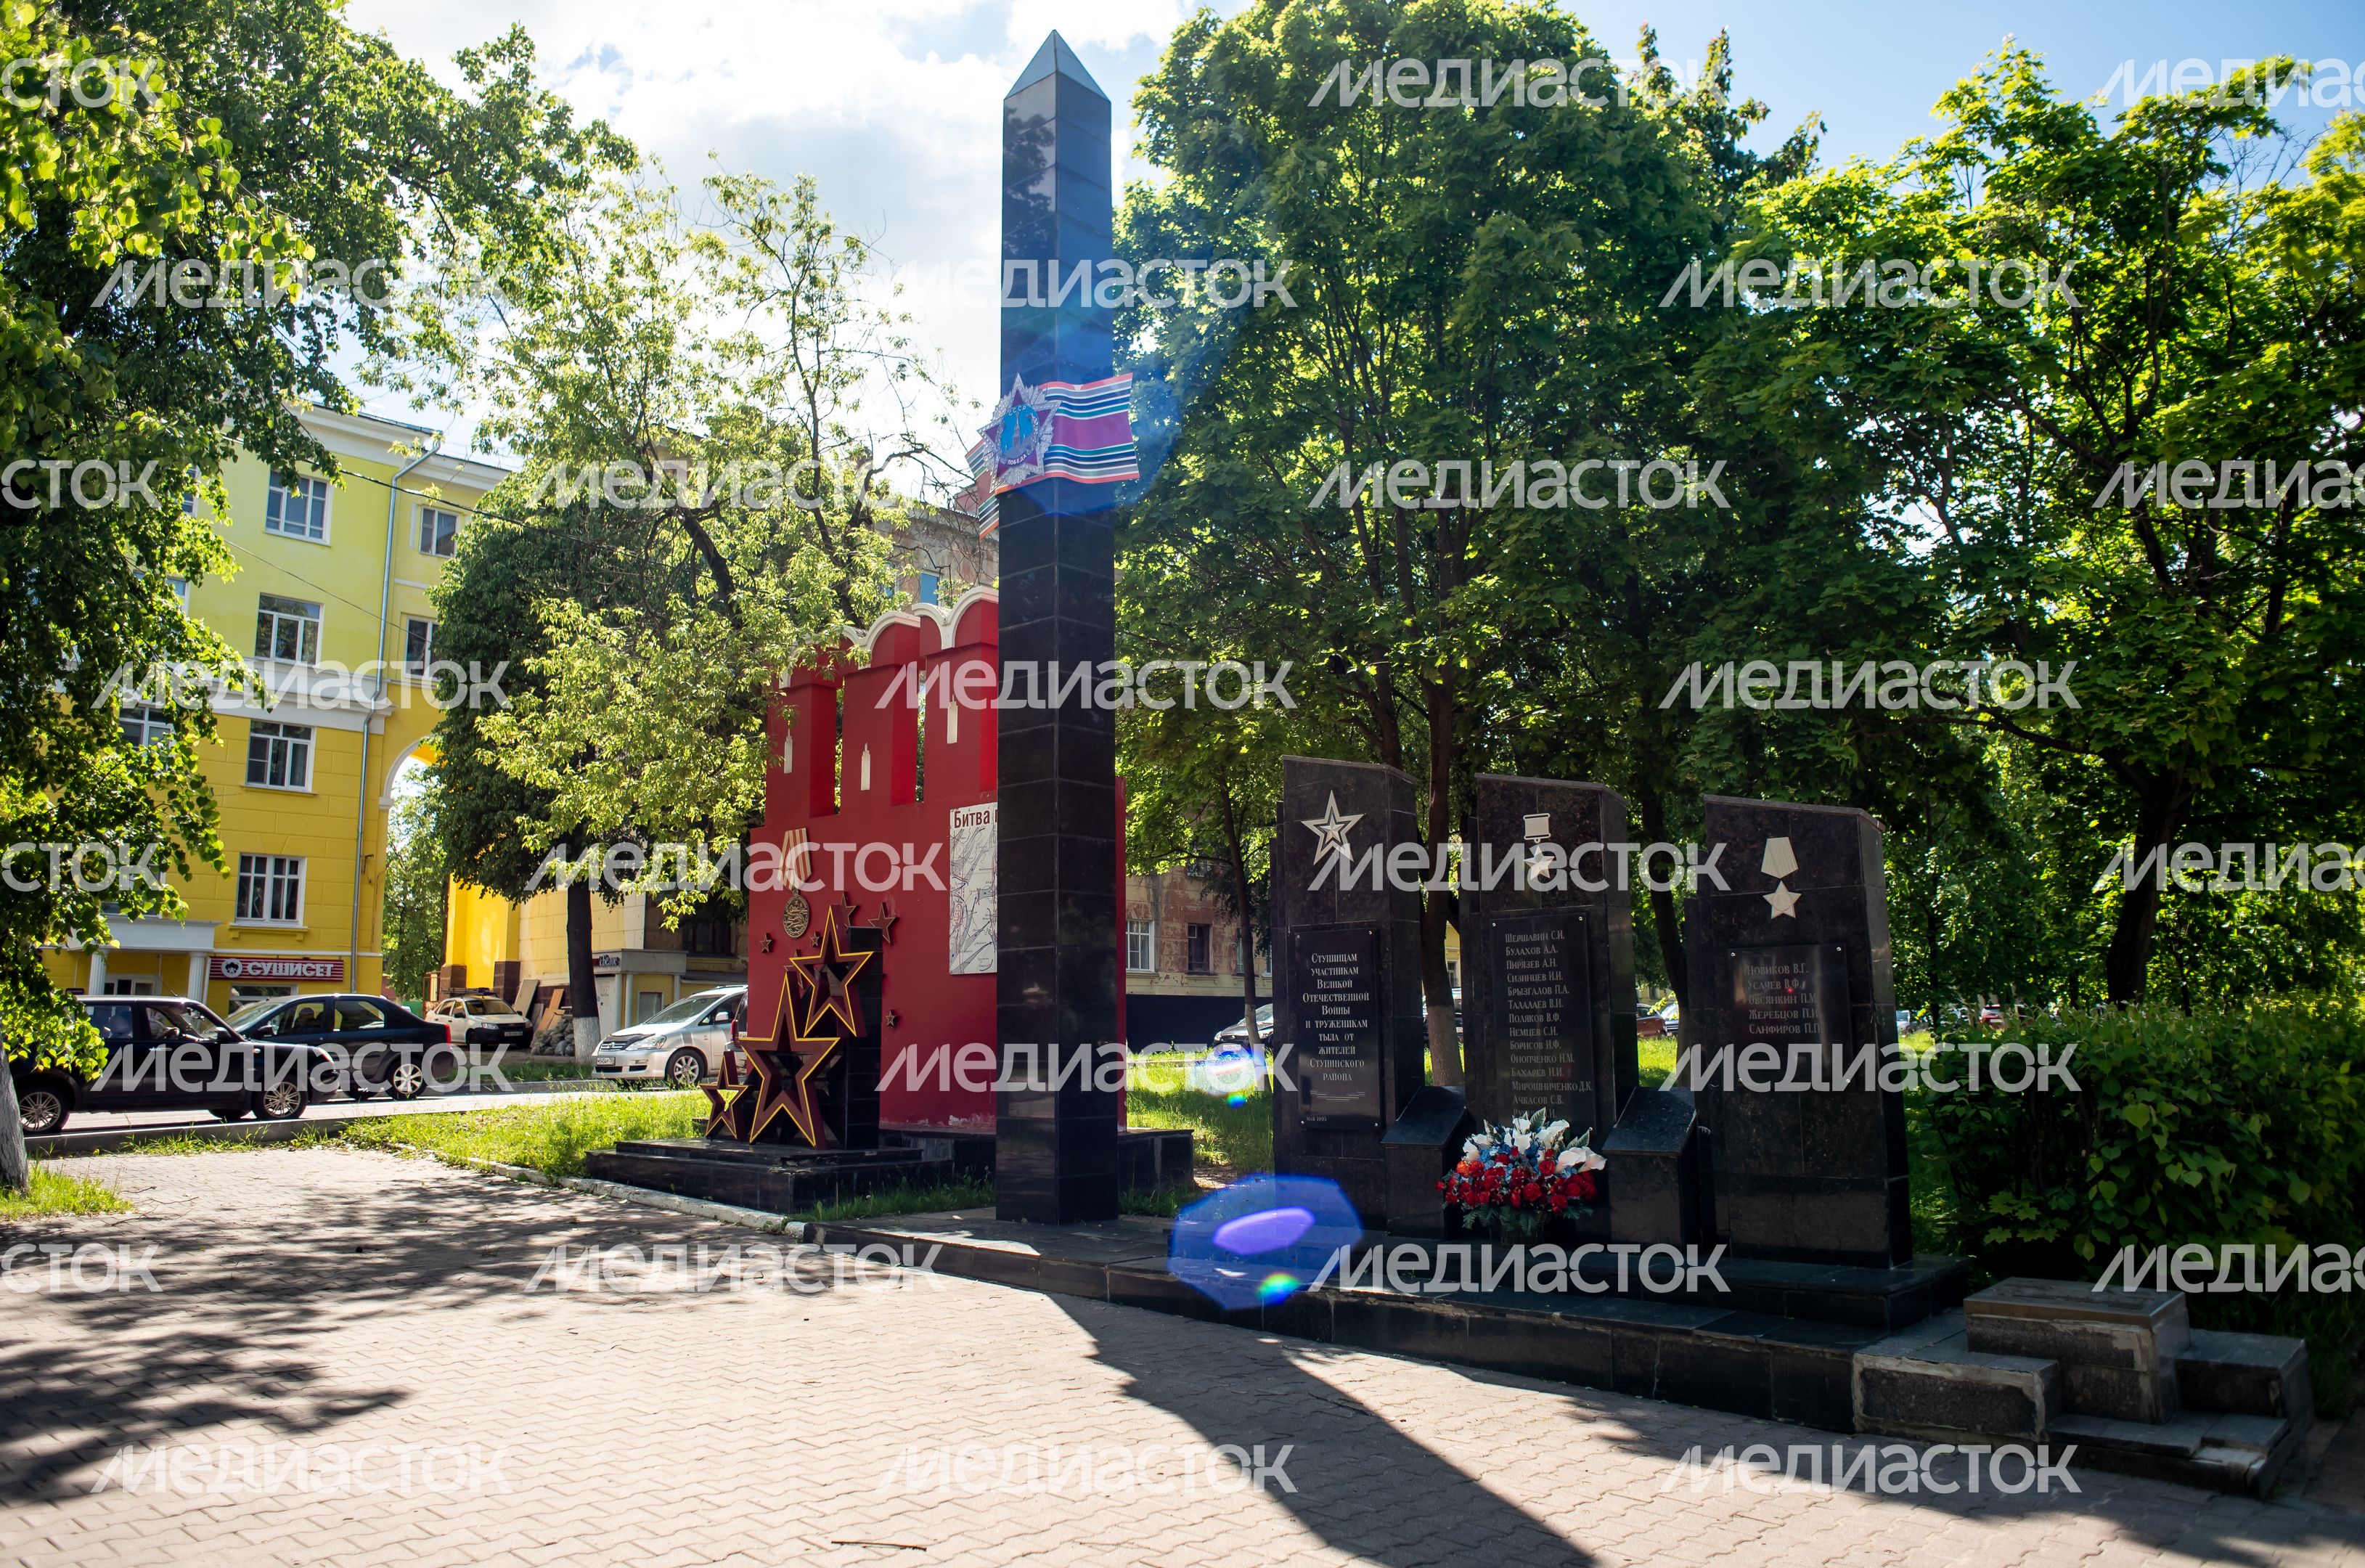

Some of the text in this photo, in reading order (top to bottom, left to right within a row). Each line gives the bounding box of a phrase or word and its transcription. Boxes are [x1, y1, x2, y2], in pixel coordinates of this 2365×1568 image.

[1009, 406, 1026, 416] СССР
[1008, 454, 1027, 465] ПОБЕДА
[955, 810, 990, 828] Битва
[247, 962, 334, 977] СУШИСЕТ
